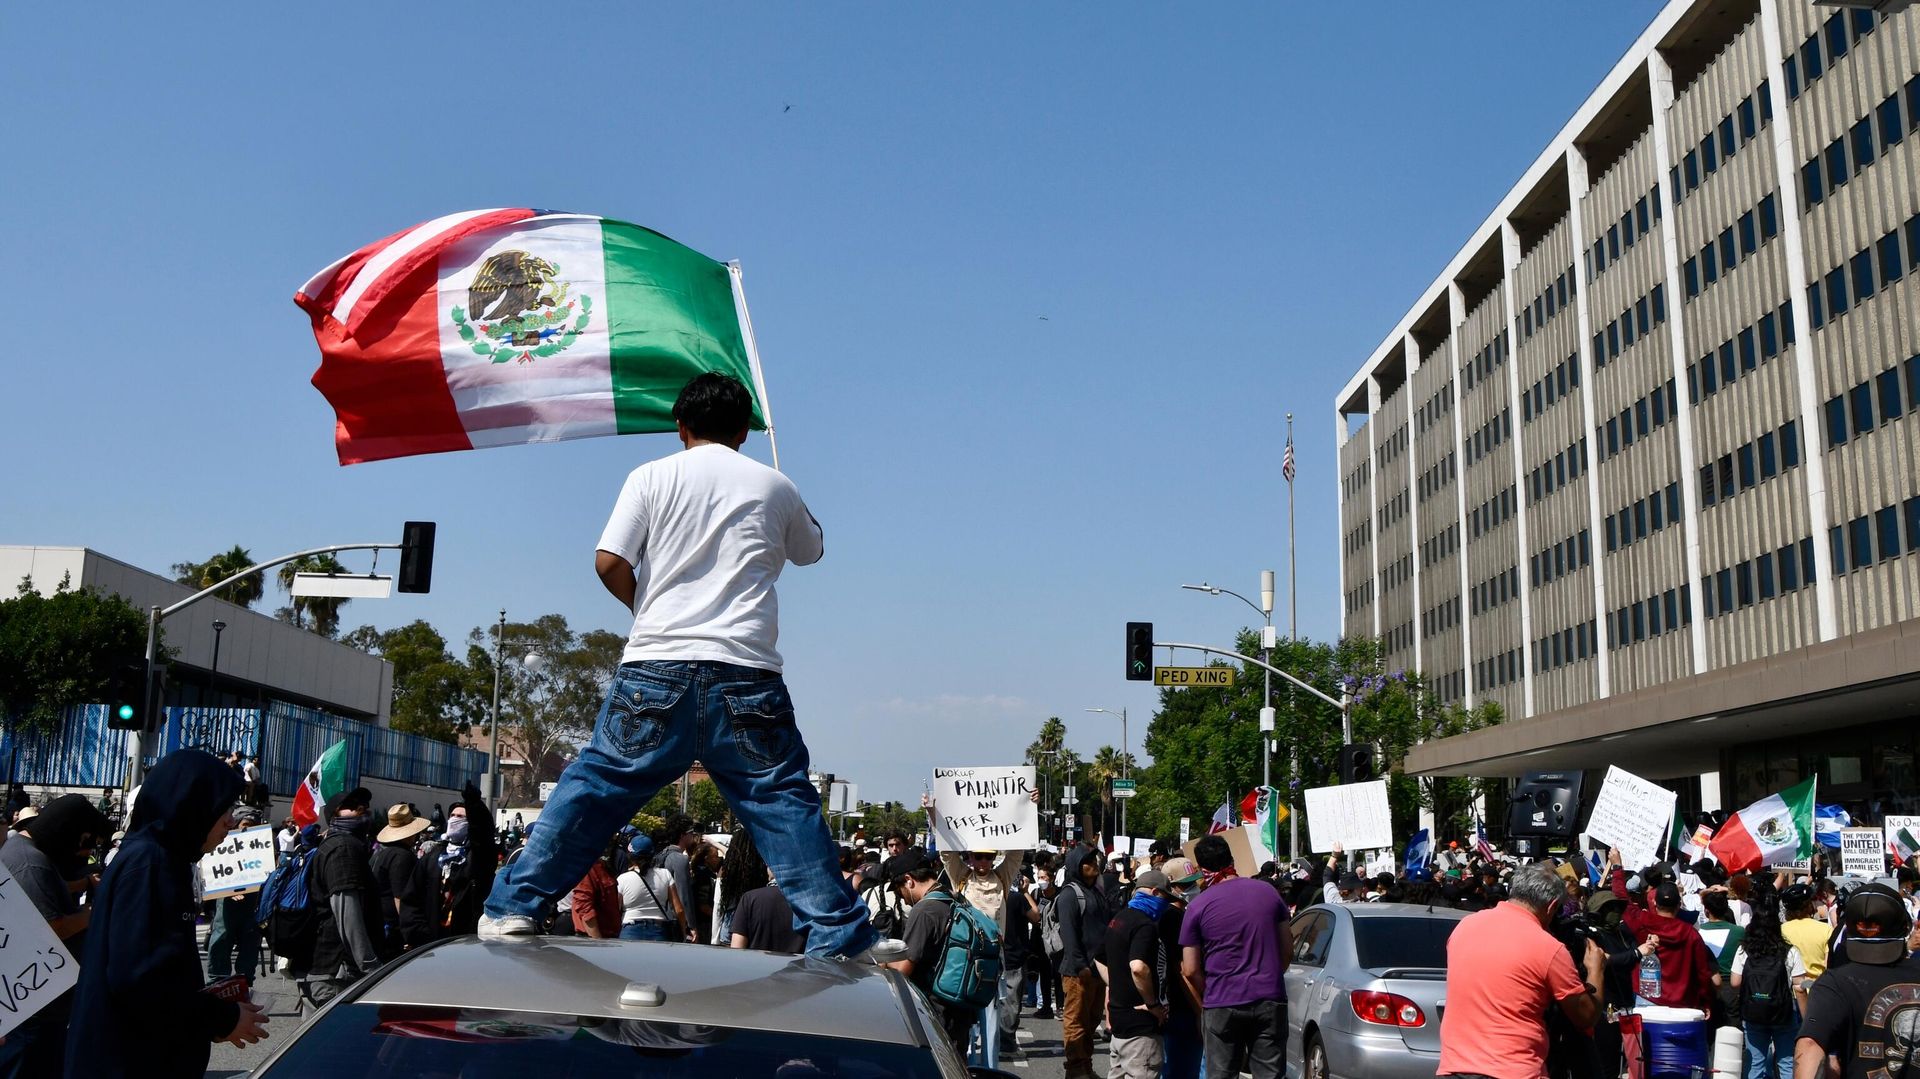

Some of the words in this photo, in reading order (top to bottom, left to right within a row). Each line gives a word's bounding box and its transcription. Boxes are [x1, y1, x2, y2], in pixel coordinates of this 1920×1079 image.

[1161, 670, 1189, 683] PED
[1195, 671, 1227, 684] XING
[977, 801, 999, 809] AND
[945, 814, 992, 830] PETER
[975, 823, 1022, 838] THIEL
[1843, 840, 1880, 849] UNITED
[1871, 988, 1903, 1021] BIKE
[1863, 1045, 1880, 1056] 20
